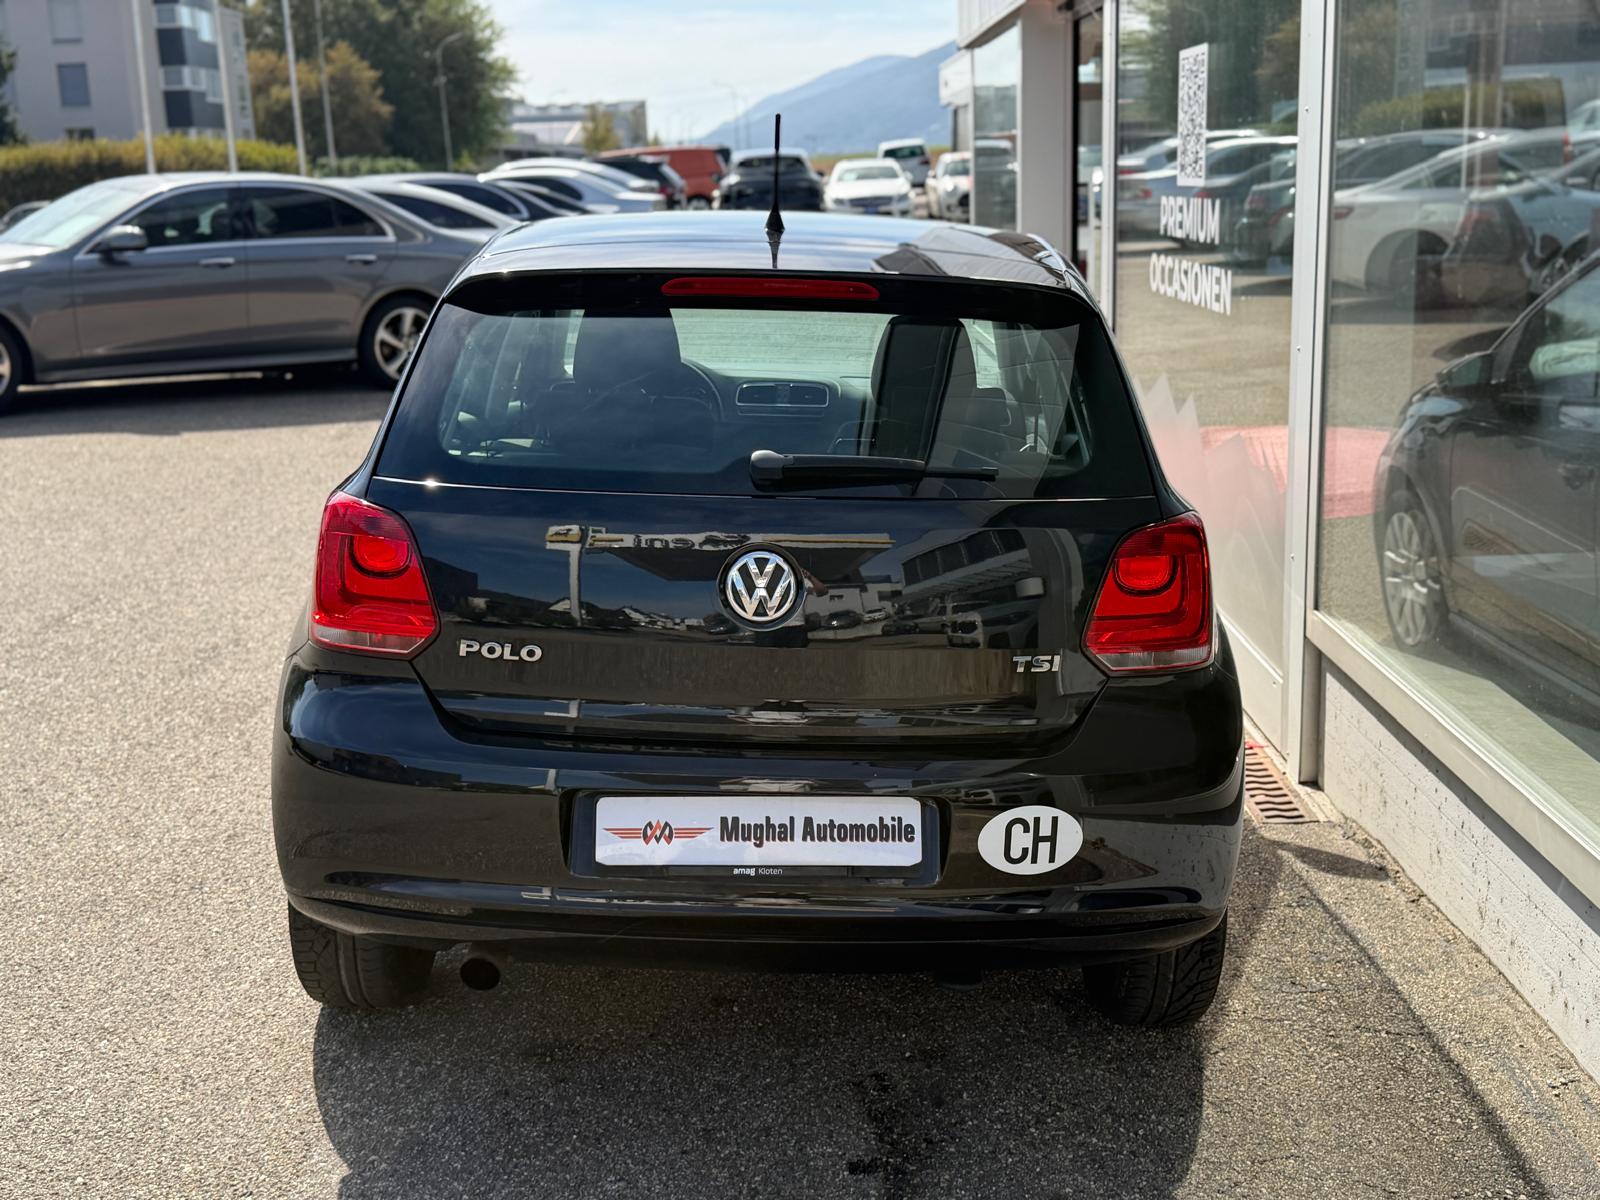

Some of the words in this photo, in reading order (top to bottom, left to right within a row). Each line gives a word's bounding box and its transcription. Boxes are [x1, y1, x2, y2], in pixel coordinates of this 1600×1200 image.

[1160, 195, 1220, 245] PREMIUM
[1150, 252, 1232, 316] OCCASIONEN
[459, 639, 542, 662] POLO
[1012, 655, 1061, 673] TSI
[719, 815, 795, 848] Mughal
[801, 816, 916, 843] Automobile
[1003, 815, 1059, 865] CH
[733, 867, 756, 876] amag
[758, 867, 783, 875] Kloten
